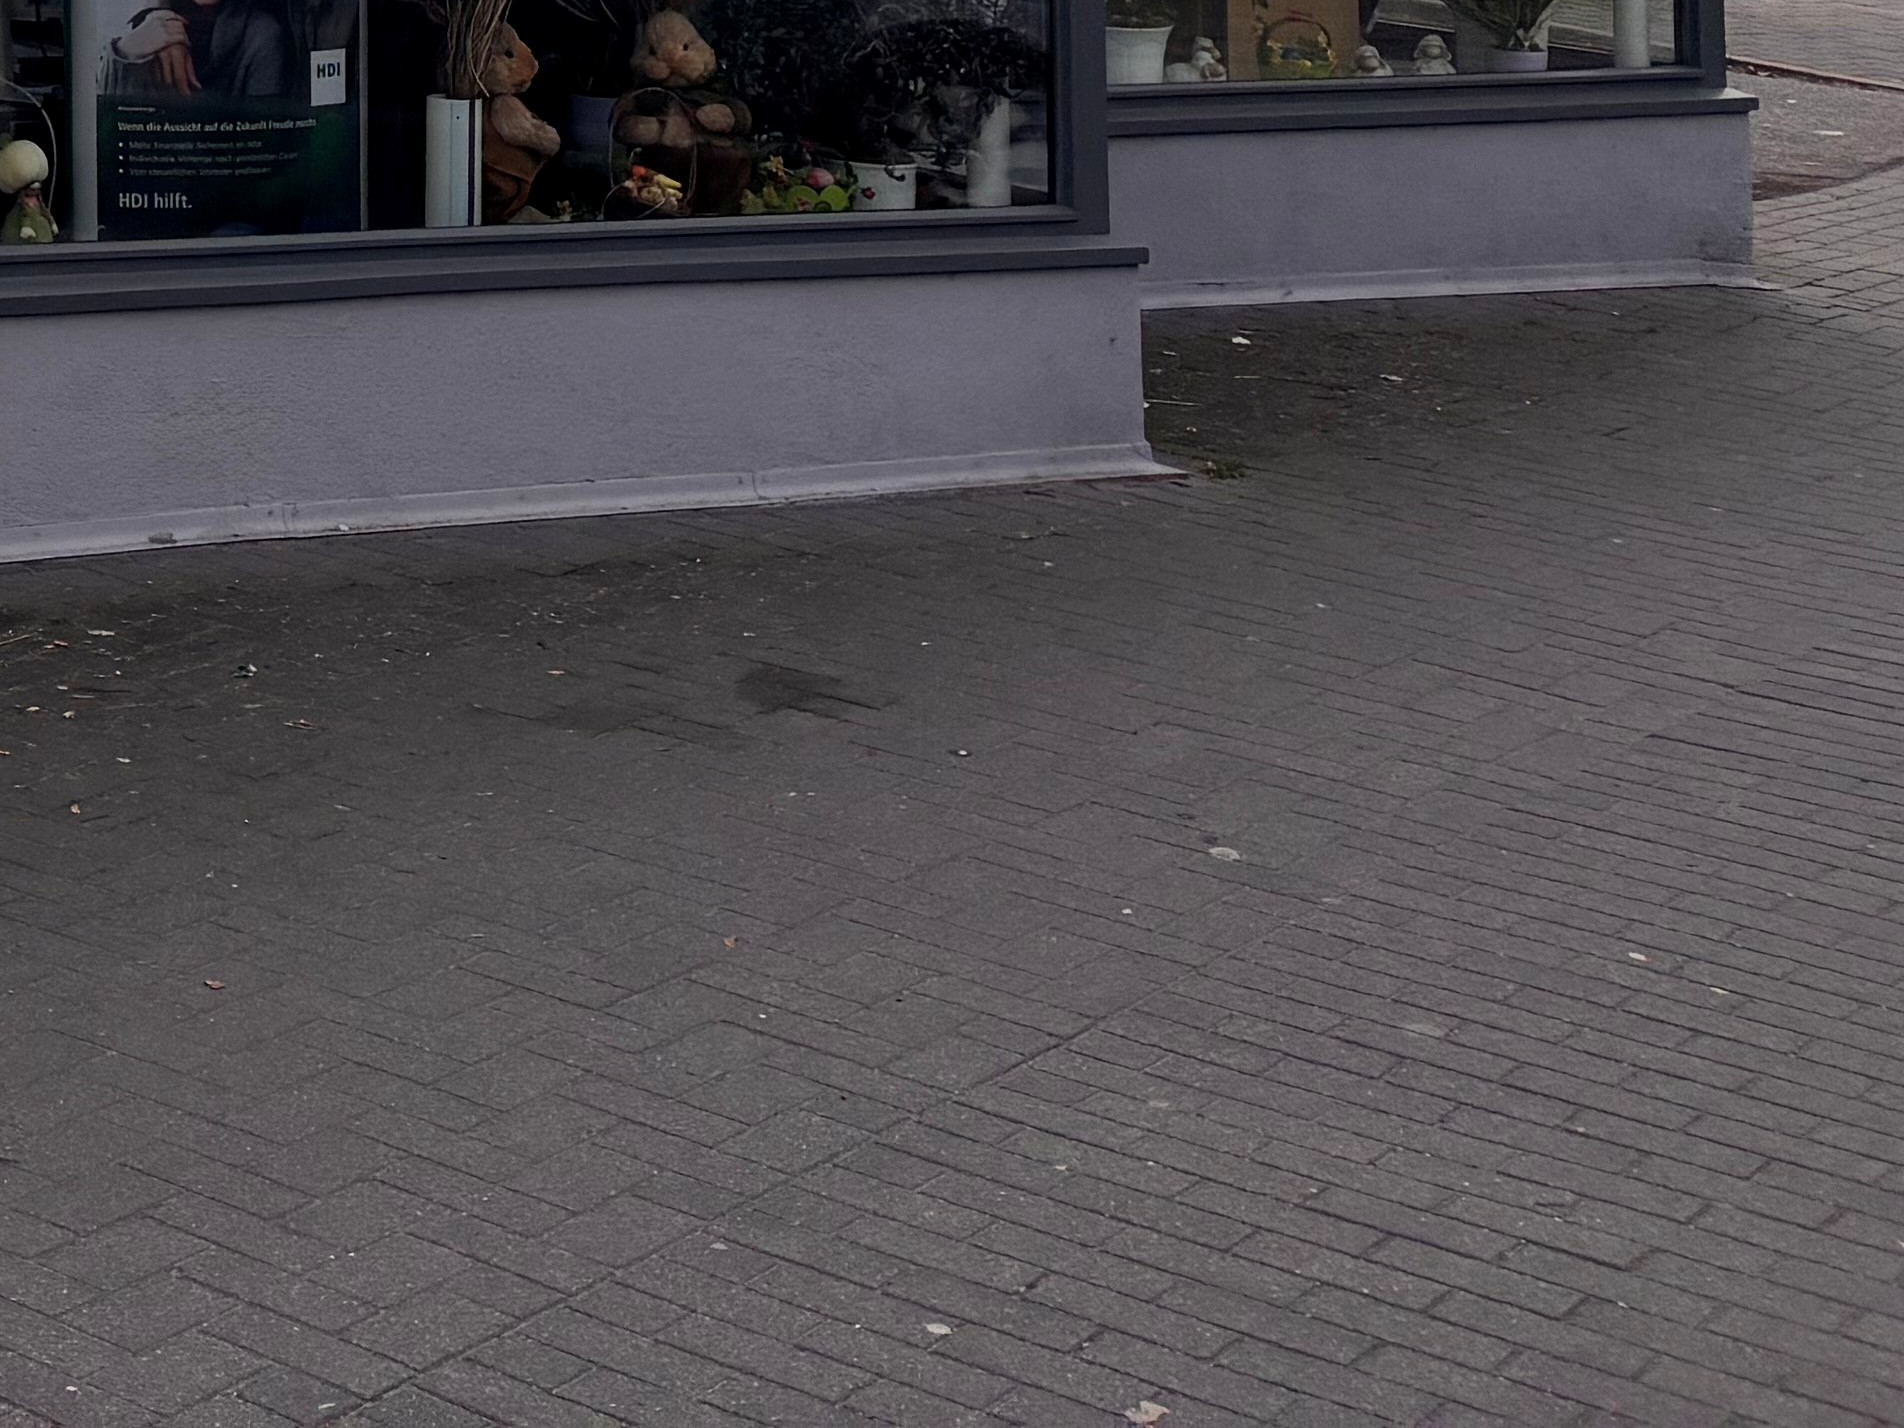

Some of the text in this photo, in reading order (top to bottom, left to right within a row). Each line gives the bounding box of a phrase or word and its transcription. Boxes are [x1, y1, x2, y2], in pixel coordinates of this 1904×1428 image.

[316, 61, 341, 79] HDI
[118, 191, 193, 209] HDI hilft.
